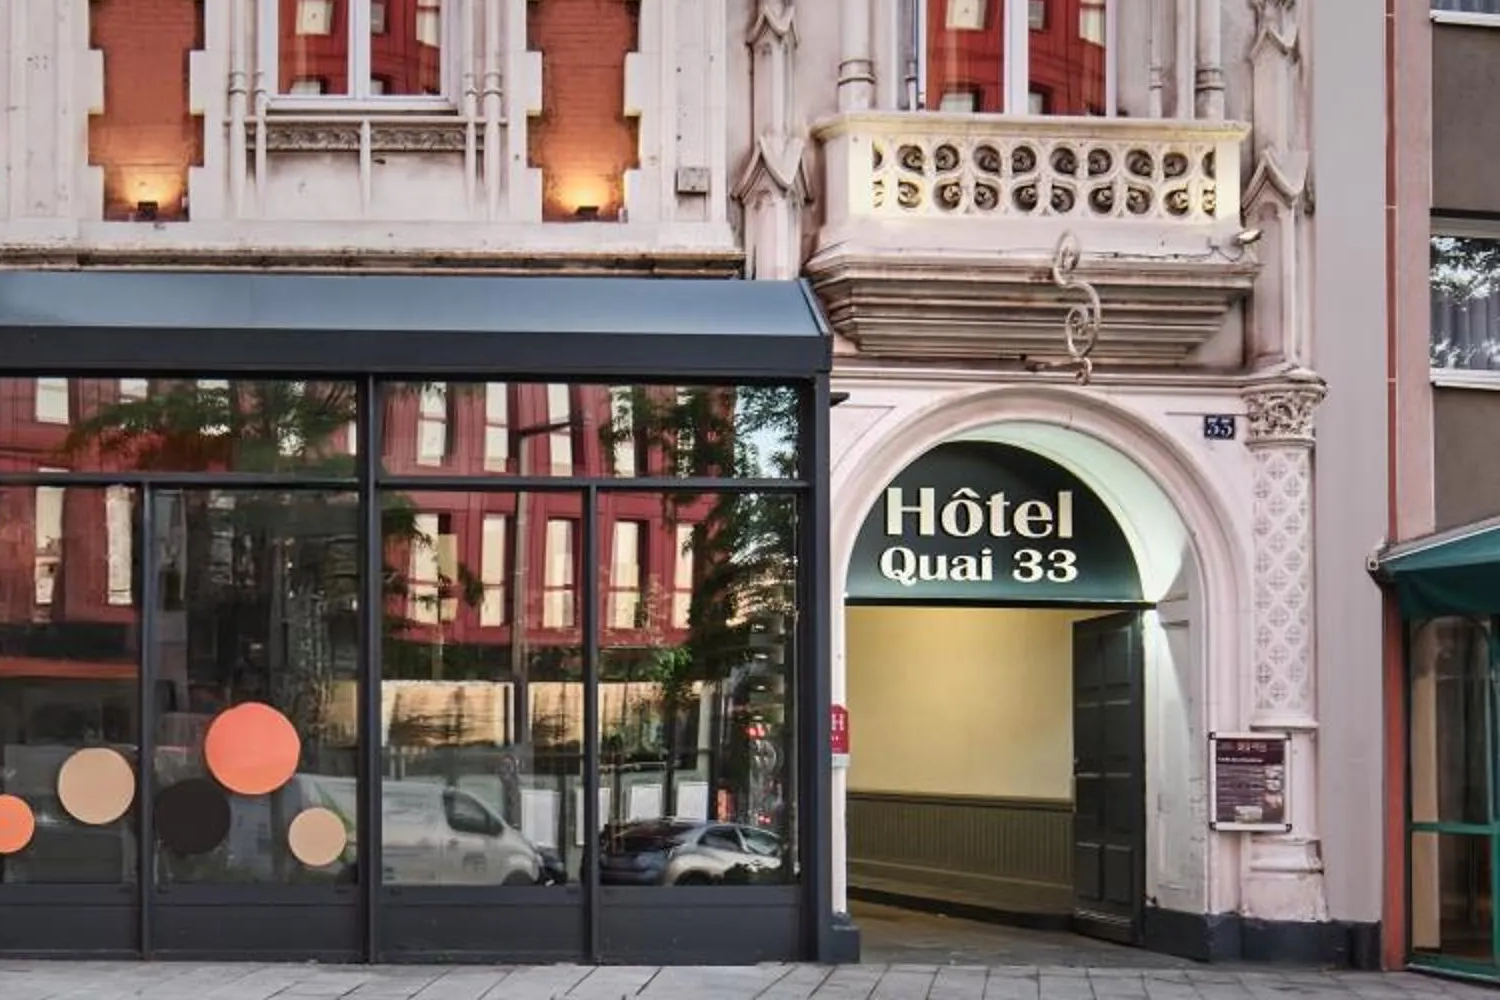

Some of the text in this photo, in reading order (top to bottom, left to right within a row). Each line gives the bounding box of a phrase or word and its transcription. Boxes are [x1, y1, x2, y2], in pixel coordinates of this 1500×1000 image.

[886, 487, 1074, 539] Hôtel
[880, 546, 1079, 586] Quai 33
[831, 713, 845, 731] H
